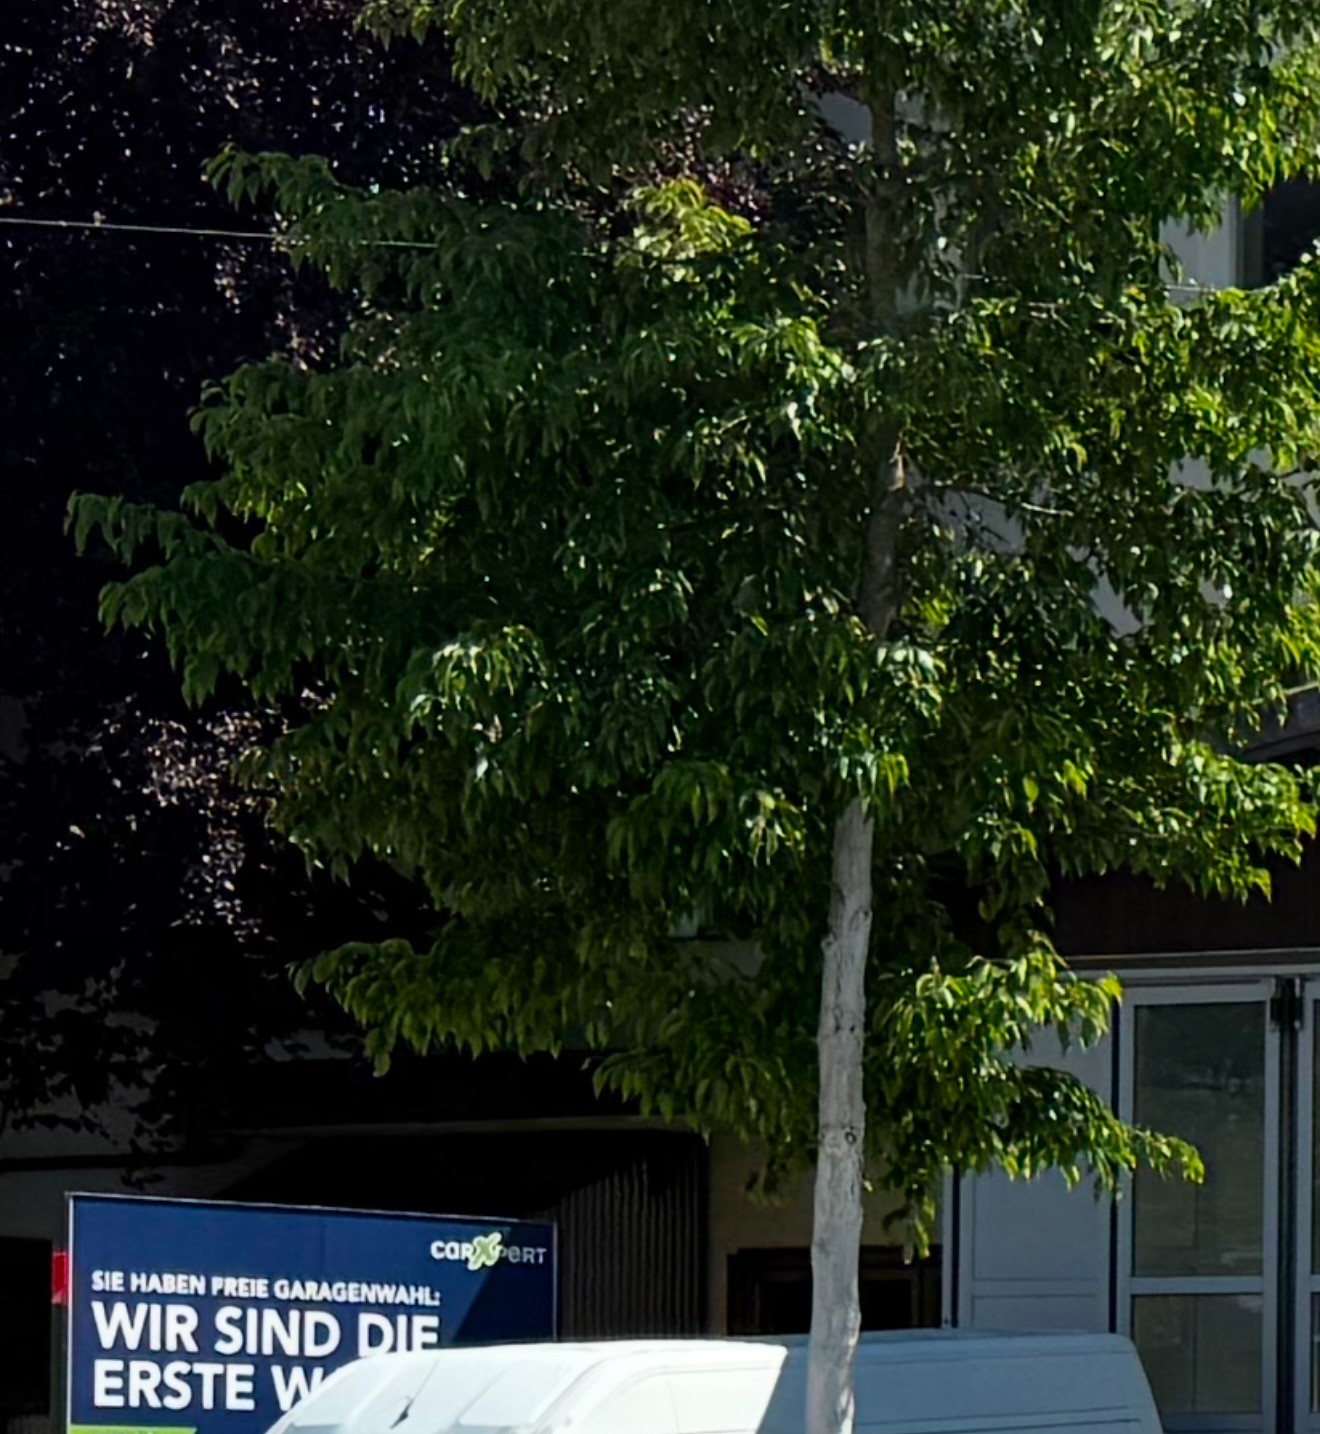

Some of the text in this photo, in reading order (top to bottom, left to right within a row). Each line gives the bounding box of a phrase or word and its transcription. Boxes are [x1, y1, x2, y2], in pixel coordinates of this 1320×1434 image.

[91, 1270, 125, 1292] SIE
[130, 1271, 206, 1296] HABEN
[273, 1278, 441, 1306] GARAGENWAHL:
[91, 1300, 440, 1358] WIR SIND DIE
[94, 1359, 255, 1411] ERSTE
